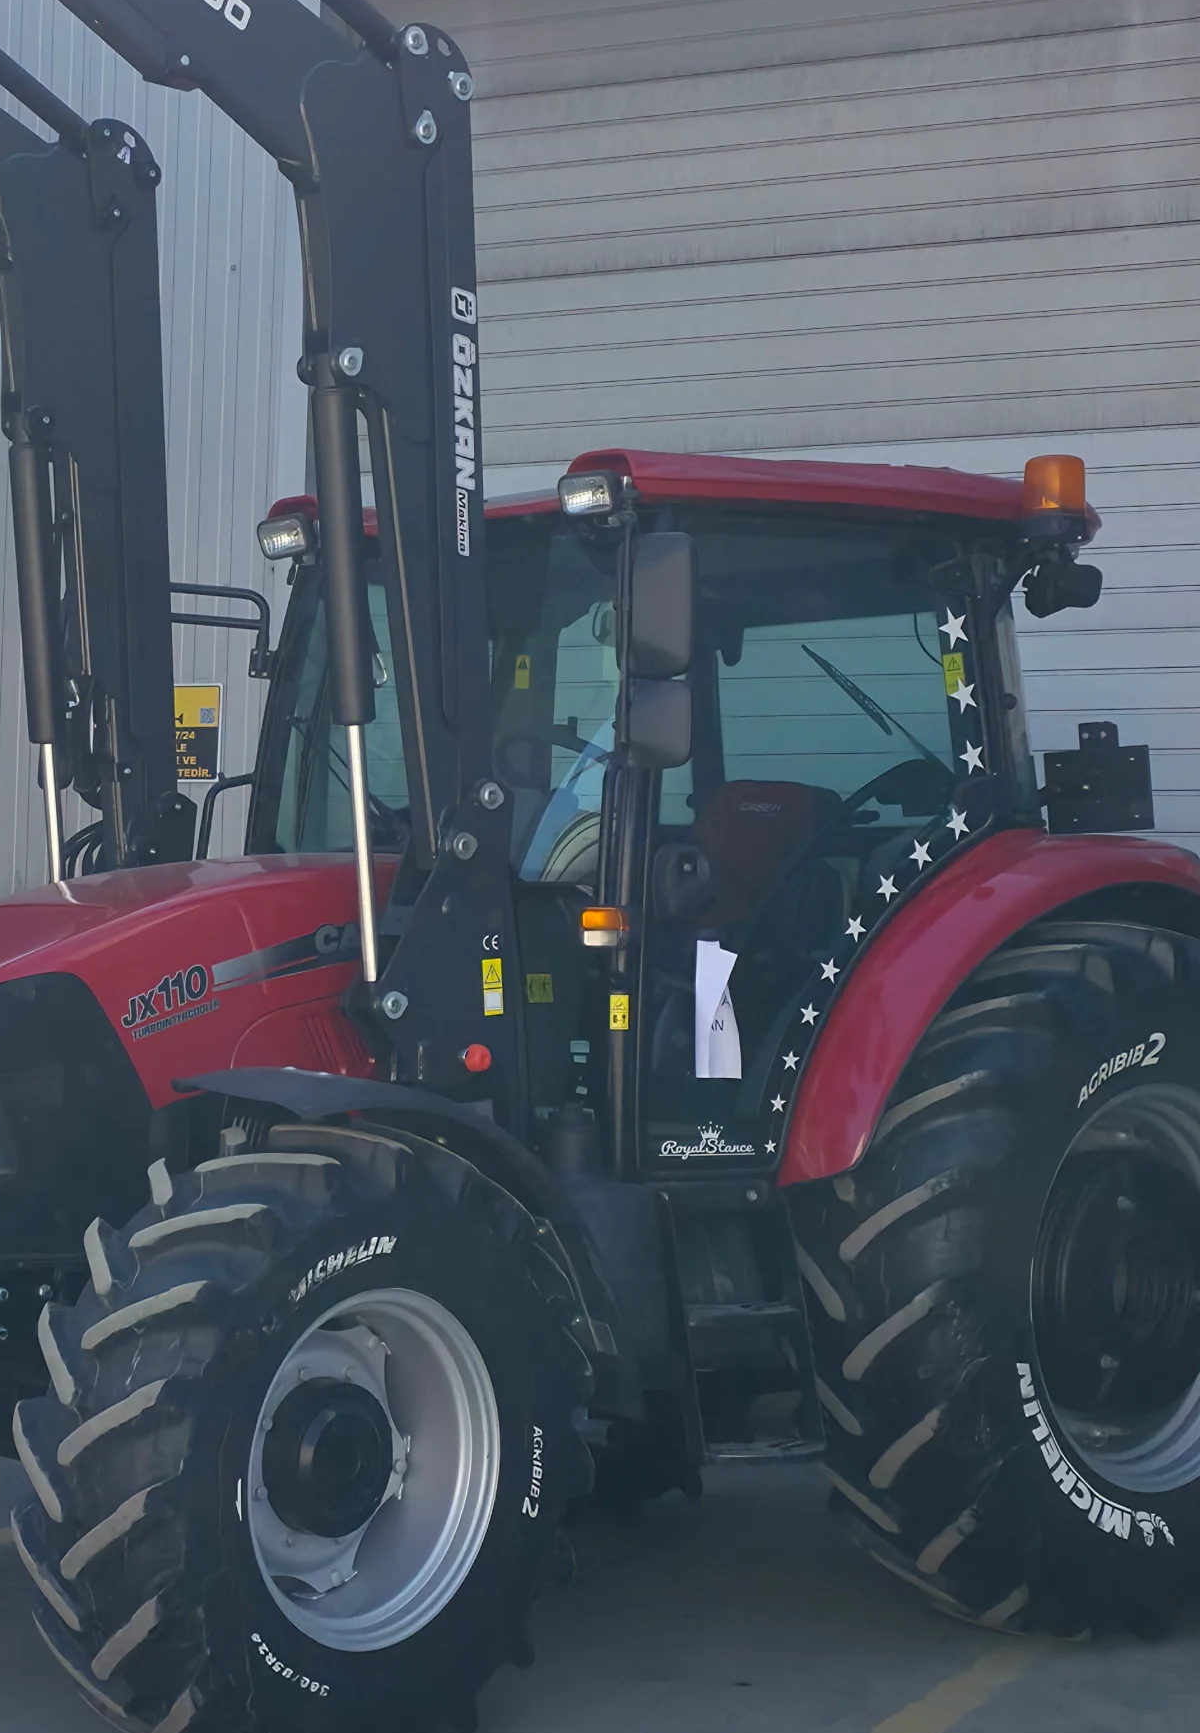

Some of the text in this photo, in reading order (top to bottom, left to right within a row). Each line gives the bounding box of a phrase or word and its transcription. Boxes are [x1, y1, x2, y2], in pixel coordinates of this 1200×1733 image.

[452, 333, 476, 491] ÖZKAN
[182, 756, 197, 765] VE
[315, 922, 362, 955] CA
[121, 964, 209, 1029] JX110
[1016, 1362, 1132, 1540] MICHELIN
